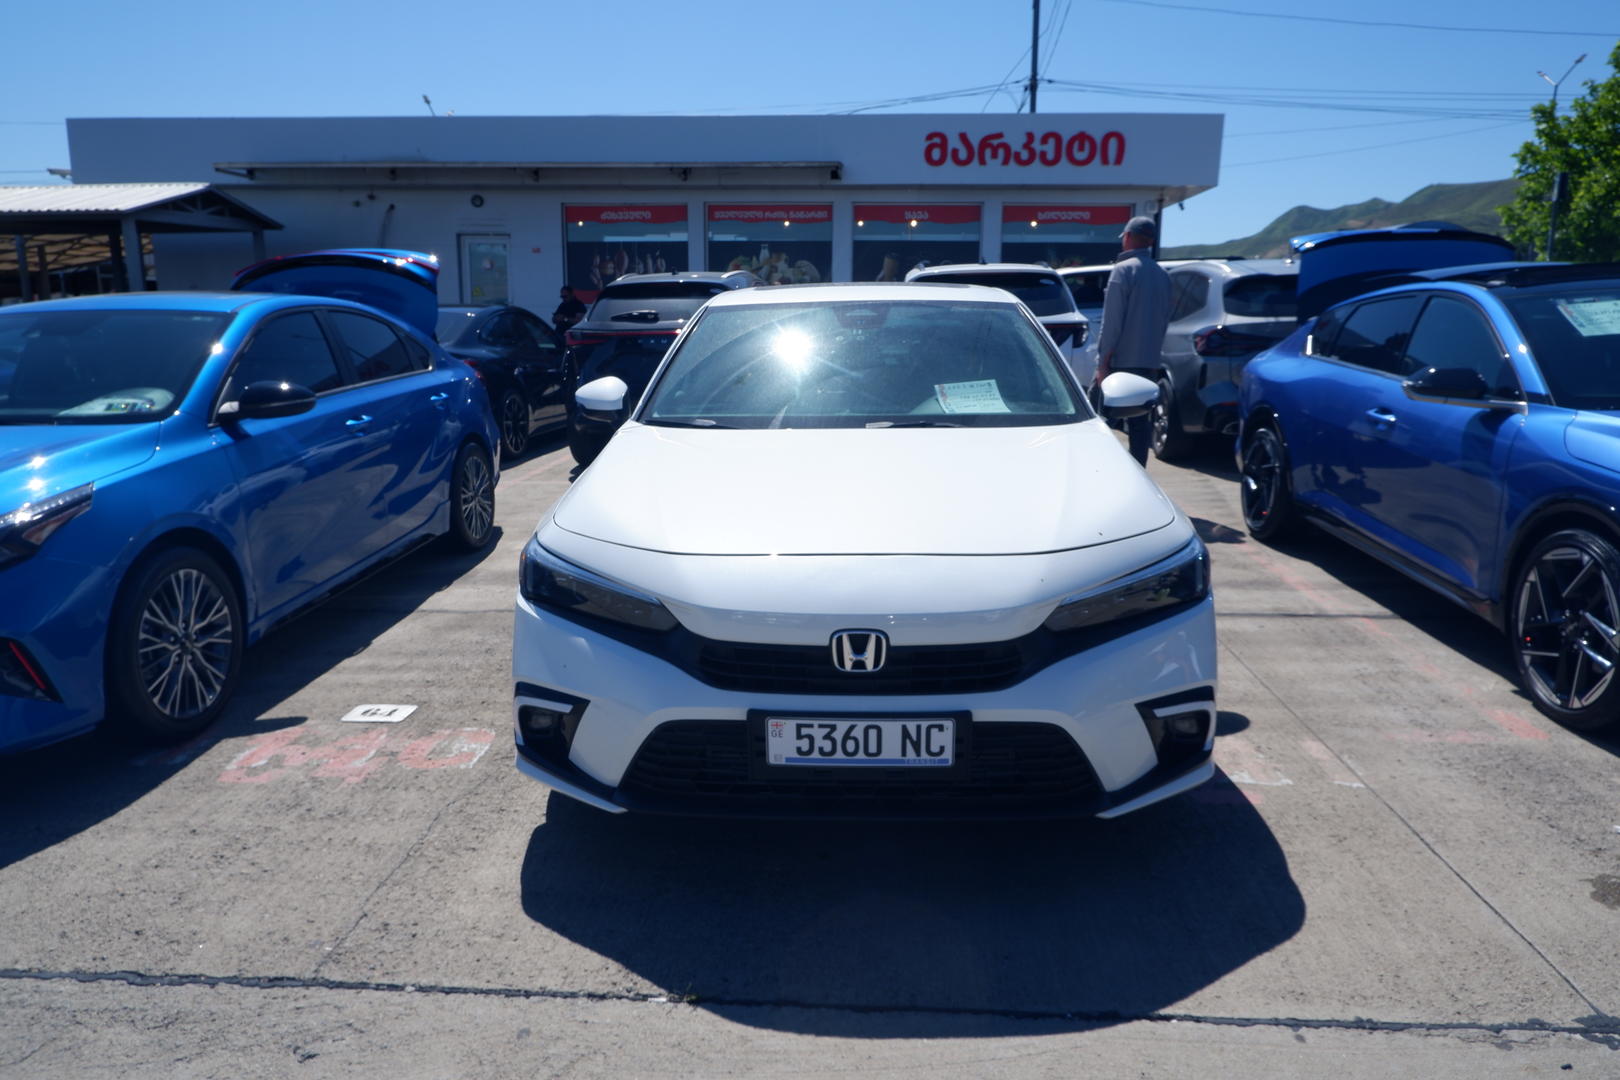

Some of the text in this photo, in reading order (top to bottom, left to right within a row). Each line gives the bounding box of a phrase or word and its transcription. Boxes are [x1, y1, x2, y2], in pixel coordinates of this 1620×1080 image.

[924, 131, 1125, 167] მარკეტი
[771, 730, 784, 738] GE
[795, 723, 945, 758] 5360 NC
